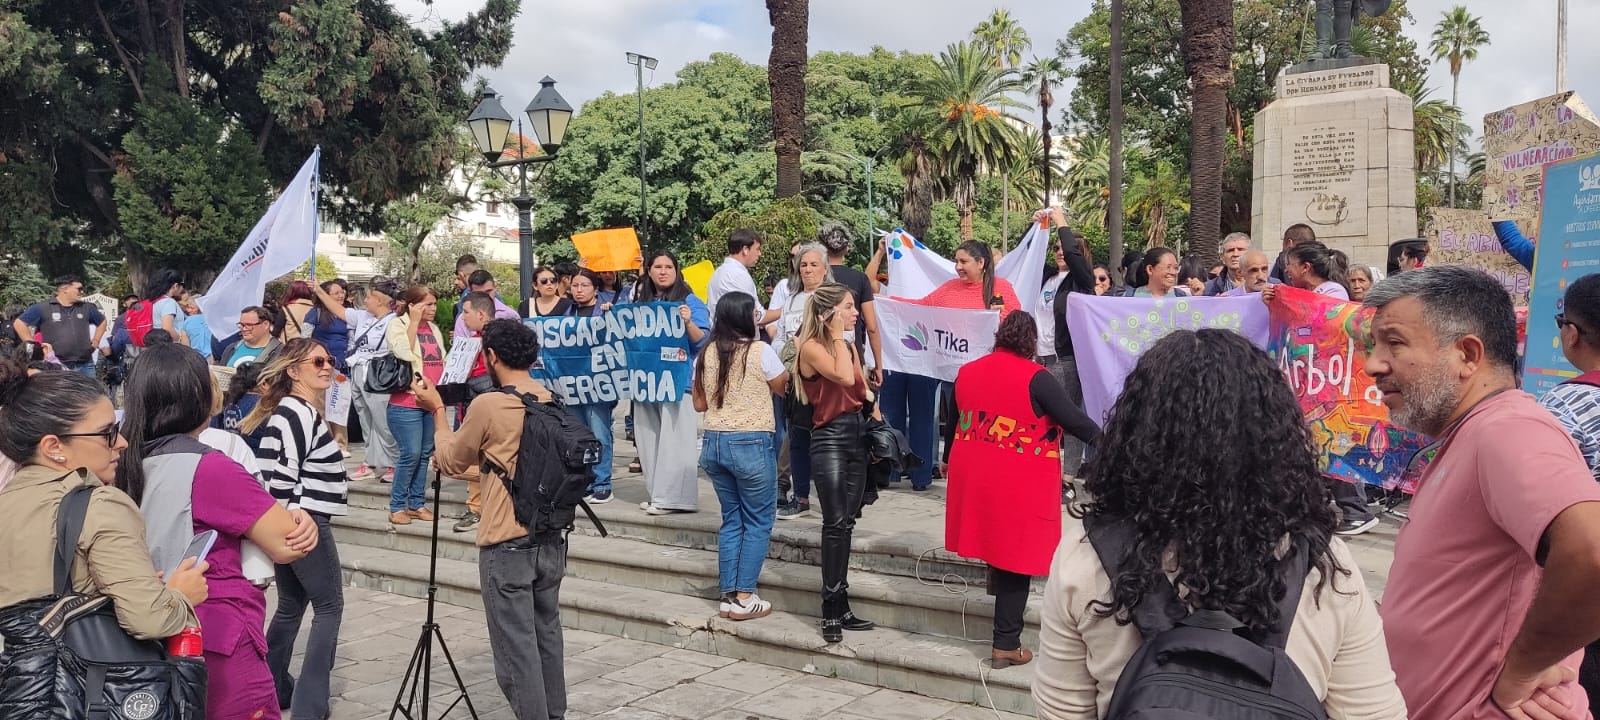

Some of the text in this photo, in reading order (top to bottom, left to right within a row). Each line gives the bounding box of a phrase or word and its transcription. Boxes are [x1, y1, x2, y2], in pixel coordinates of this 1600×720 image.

[1441, 229, 1461, 249] EL
[934, 329, 969, 353] Tika
[591, 341, 628, 373] EN
